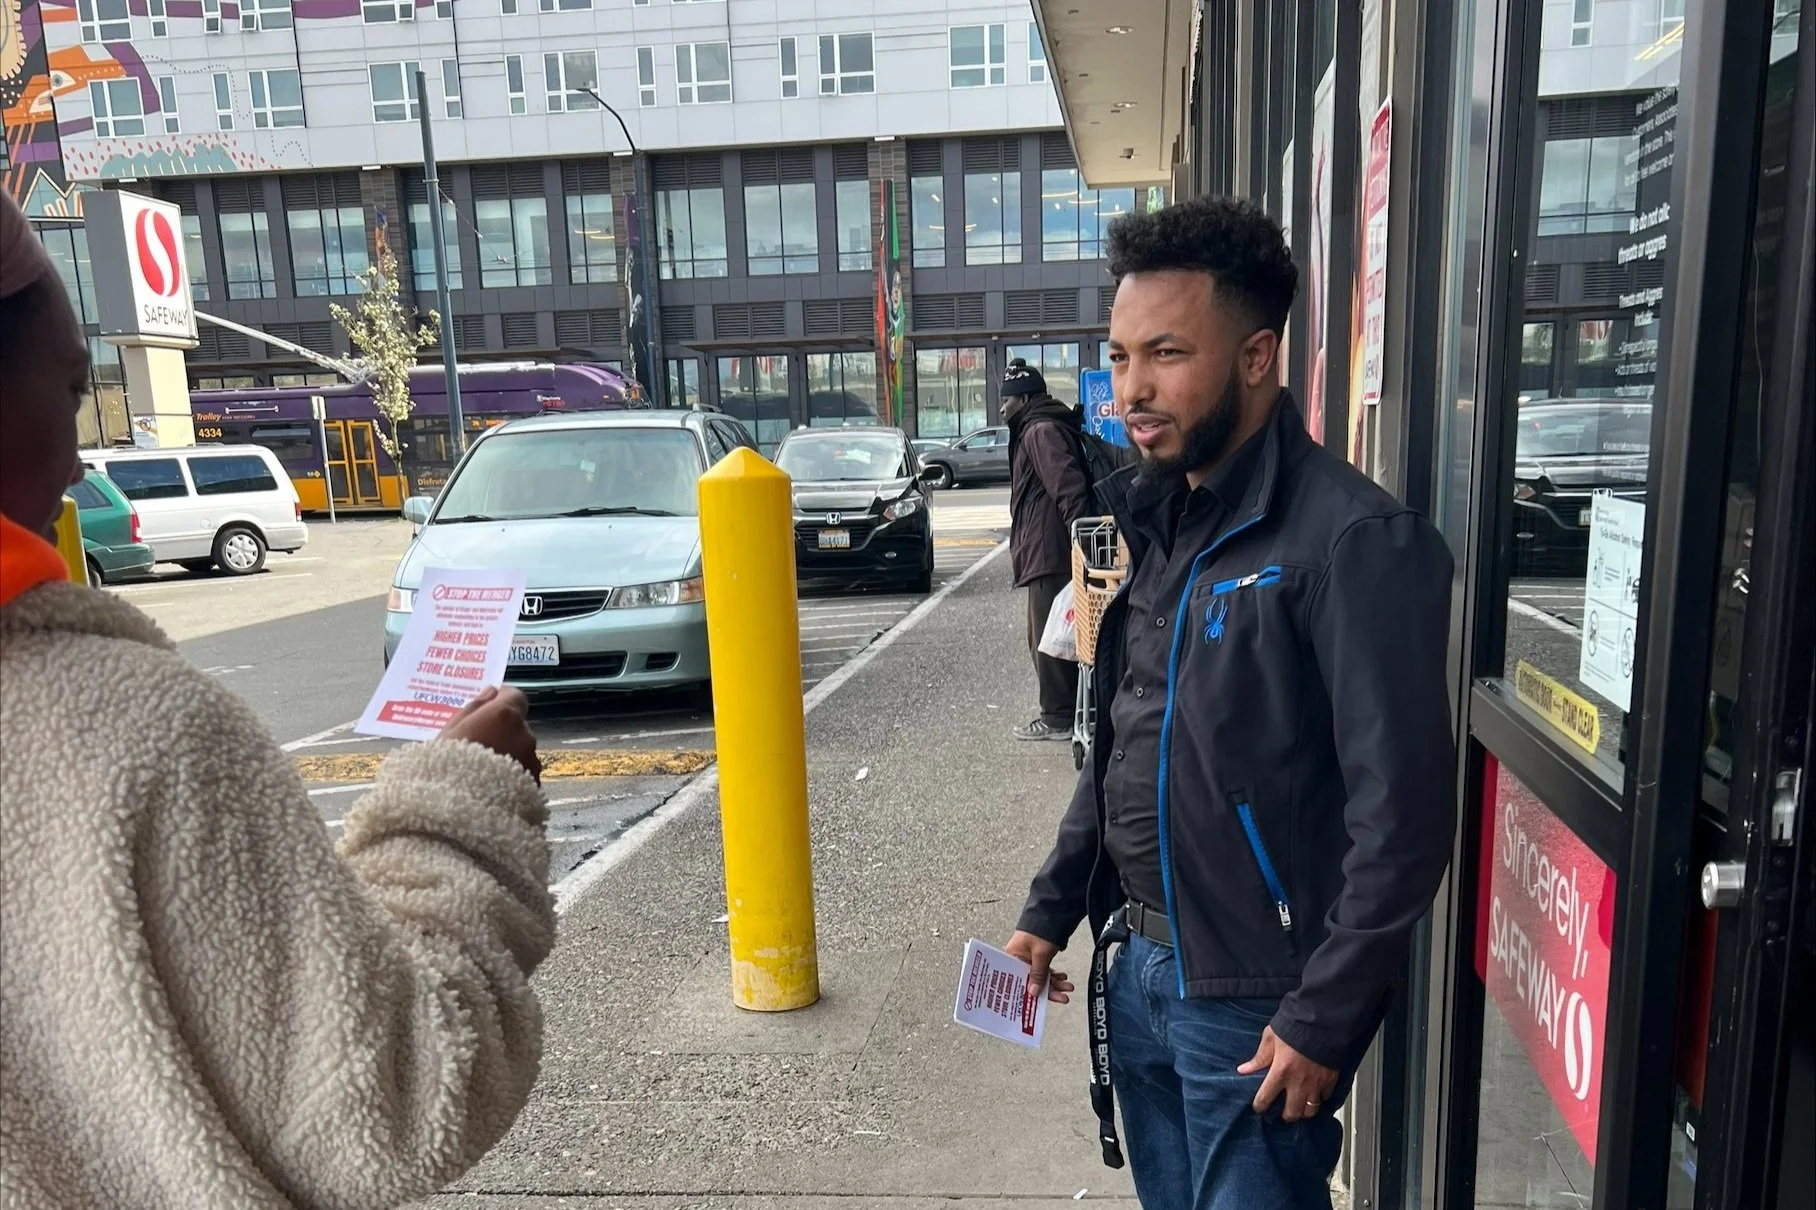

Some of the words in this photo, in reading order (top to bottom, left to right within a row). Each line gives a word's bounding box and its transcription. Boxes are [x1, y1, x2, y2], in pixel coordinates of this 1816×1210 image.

[1639, 211, 1648, 230] do
[1648, 207, 1658, 226] not
[144, 304, 188, 327] SAFEWAY
[197, 412, 222, 423] Trolley
[198, 427, 222, 438] 4334
[448, 588, 468, 600] STOP
[434, 630, 462, 644] HIGHER
[462, 632, 490, 647] PRICES
[426, 646, 455, 660] FEWER
[454, 649, 487, 663] CHOICES
[508, 646, 555, 661] YG8472
[416, 661, 444, 675] STORE
[443, 664, 484, 680] CLOSURES
[1562, 696, 1577, 731] STAND
[1578, 707, 1594, 743] CLEAR
[1502, 801, 1590, 979] Sincerely,
[1490, 896, 1566, 1049] SAFEWAY
[993, 995, 1002, 1013] FEWER
[1096, 996, 1108, 1040] BOYD
[1098, 1043, 1110, 1086] BOYD
